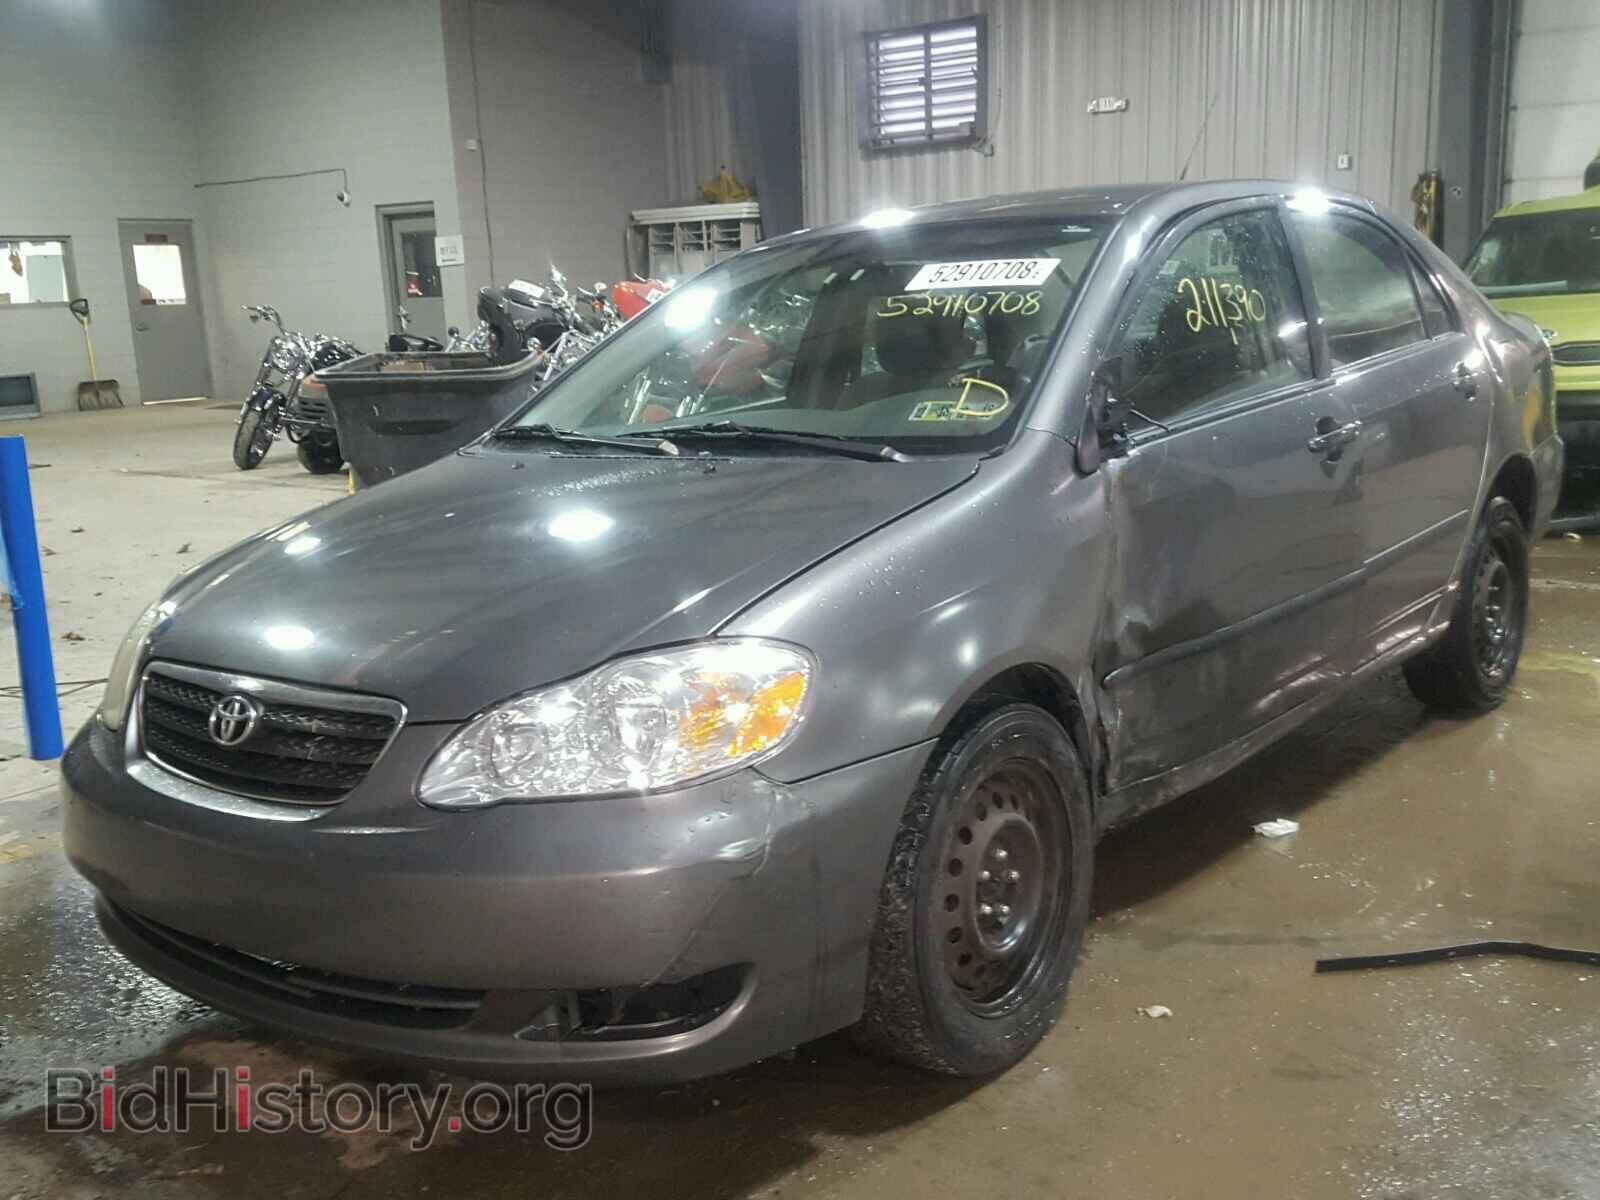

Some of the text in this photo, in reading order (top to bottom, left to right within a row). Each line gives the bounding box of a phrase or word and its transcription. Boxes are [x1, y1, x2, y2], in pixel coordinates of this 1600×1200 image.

[928, 261, 1038, 283] 52910708
[877, 290, 1043, 317] 52910708
[1177, 277, 1266, 332] 211390
[955, 377, 1009, 416] D
